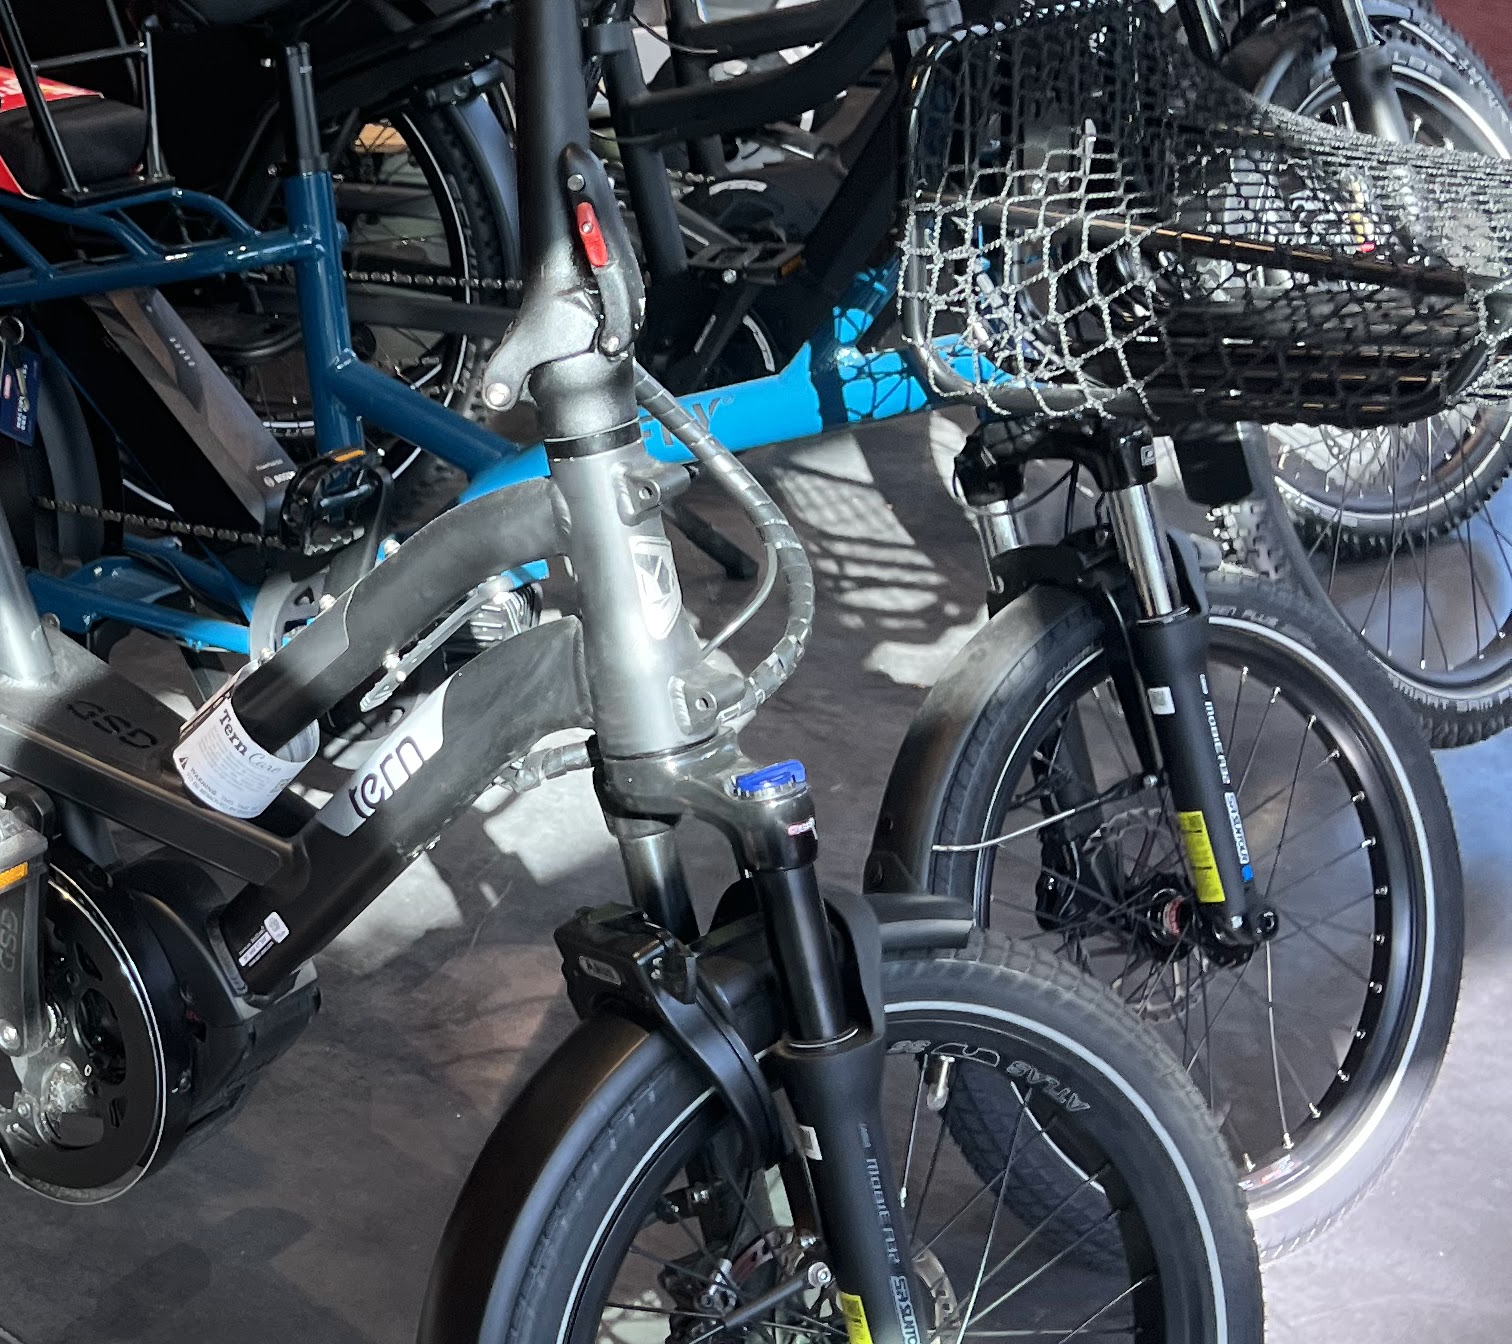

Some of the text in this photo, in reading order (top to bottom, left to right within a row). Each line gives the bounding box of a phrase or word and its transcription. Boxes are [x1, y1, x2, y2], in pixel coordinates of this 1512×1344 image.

[67, 700, 158, 749] GSD
[219, 708, 248, 756] Tern
[248, 752, 281, 774] Care
[190, 767, 217, 796] WARNING
[0, 909, 18, 973] GSD
